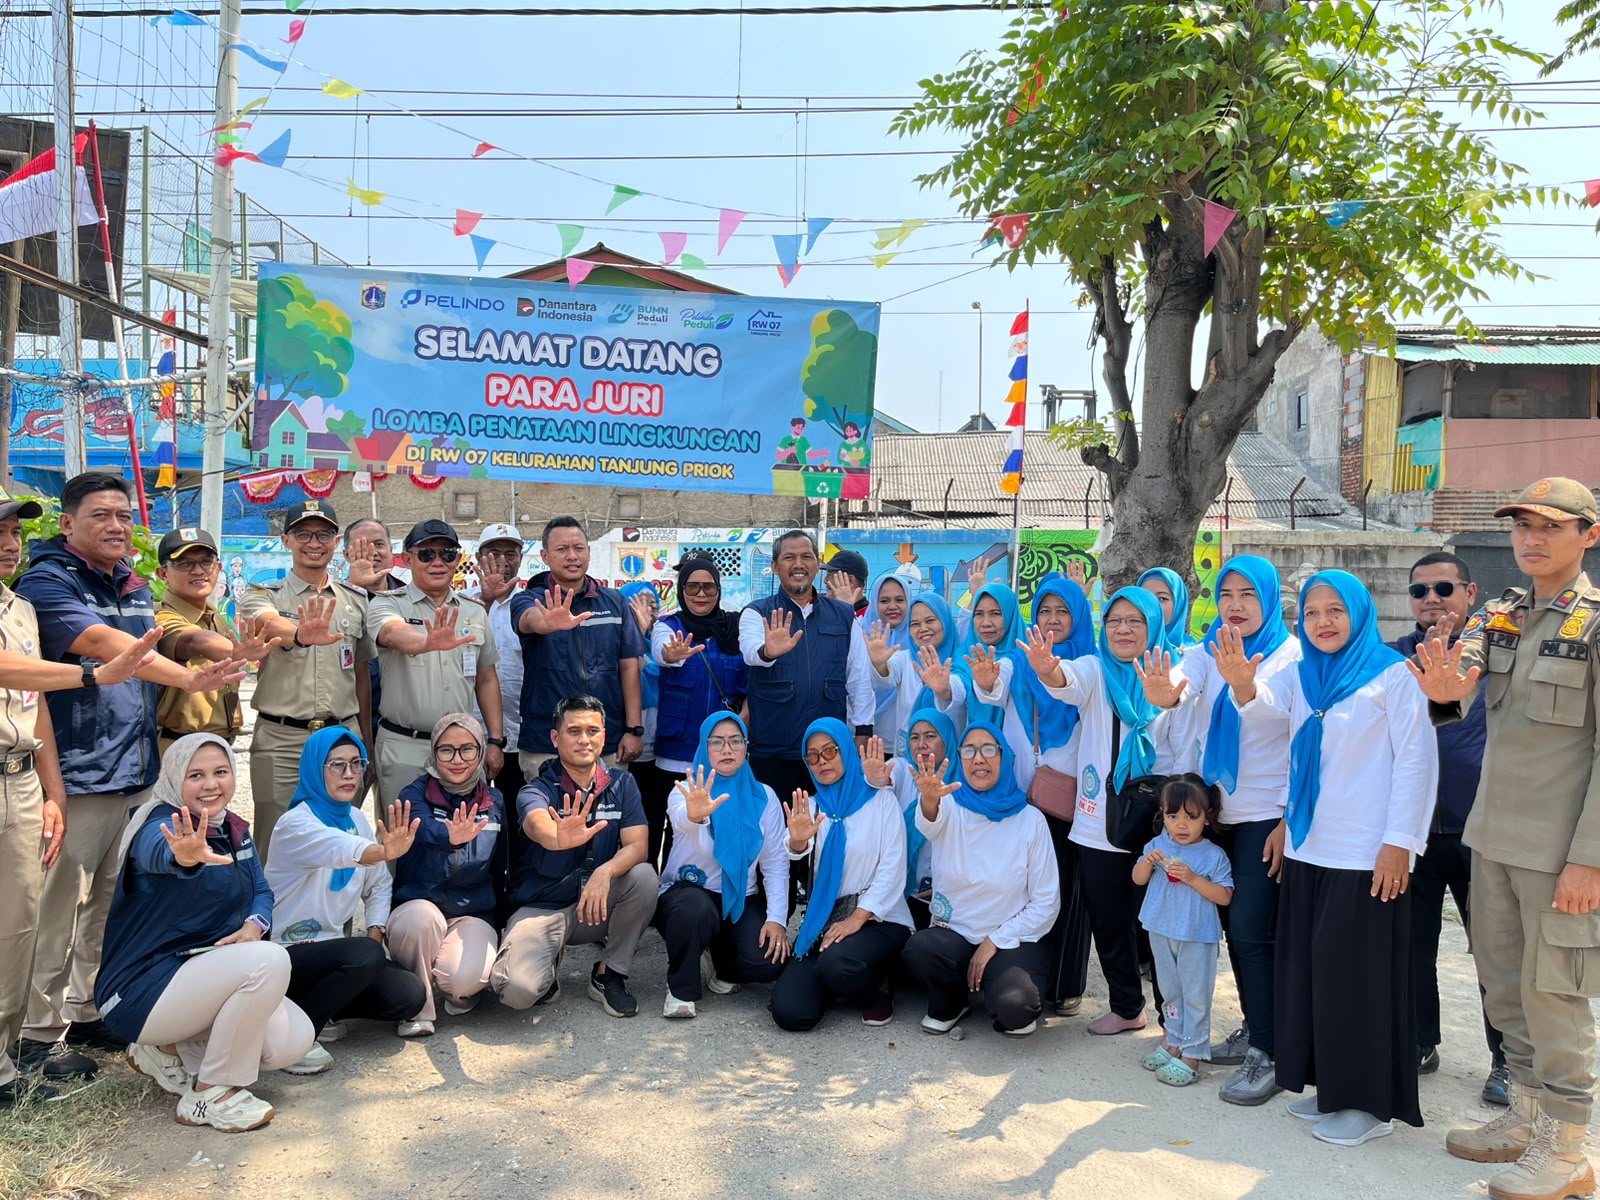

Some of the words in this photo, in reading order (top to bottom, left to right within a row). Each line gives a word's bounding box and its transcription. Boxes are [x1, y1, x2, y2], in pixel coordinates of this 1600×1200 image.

[425, 295, 504, 311] PELINDO
[538, 298, 596, 312] Danantara
[638, 305, 668, 314] BUMN
[538, 309, 592, 322] Indonesia
[637, 314, 668, 322] Peduli
[684, 320, 714, 329] Peduli
[752, 320, 766, 328] RW
[769, 322, 781, 330] 07
[415, 325, 576, 367] SELAMAT
[580, 336, 722, 378] DATANG
[486, 374, 581, 414] PARA
[584, 380, 664, 417] JURI
[372, 408, 464, 436] LOMBA
[469, 413, 596, 445] PENATAAN
[600, 422, 760, 453] LINGKUNGAN
[406, 446, 426, 462] DI
[430, 446, 462, 464] RW
[464, 449, 488, 465] 07
[491, 450, 595, 472] KELURAHAN
[599, 456, 679, 478] TANJUNG
[682, 461, 735, 480] PRIOK
[1566, 644, 1586, 658] PP
